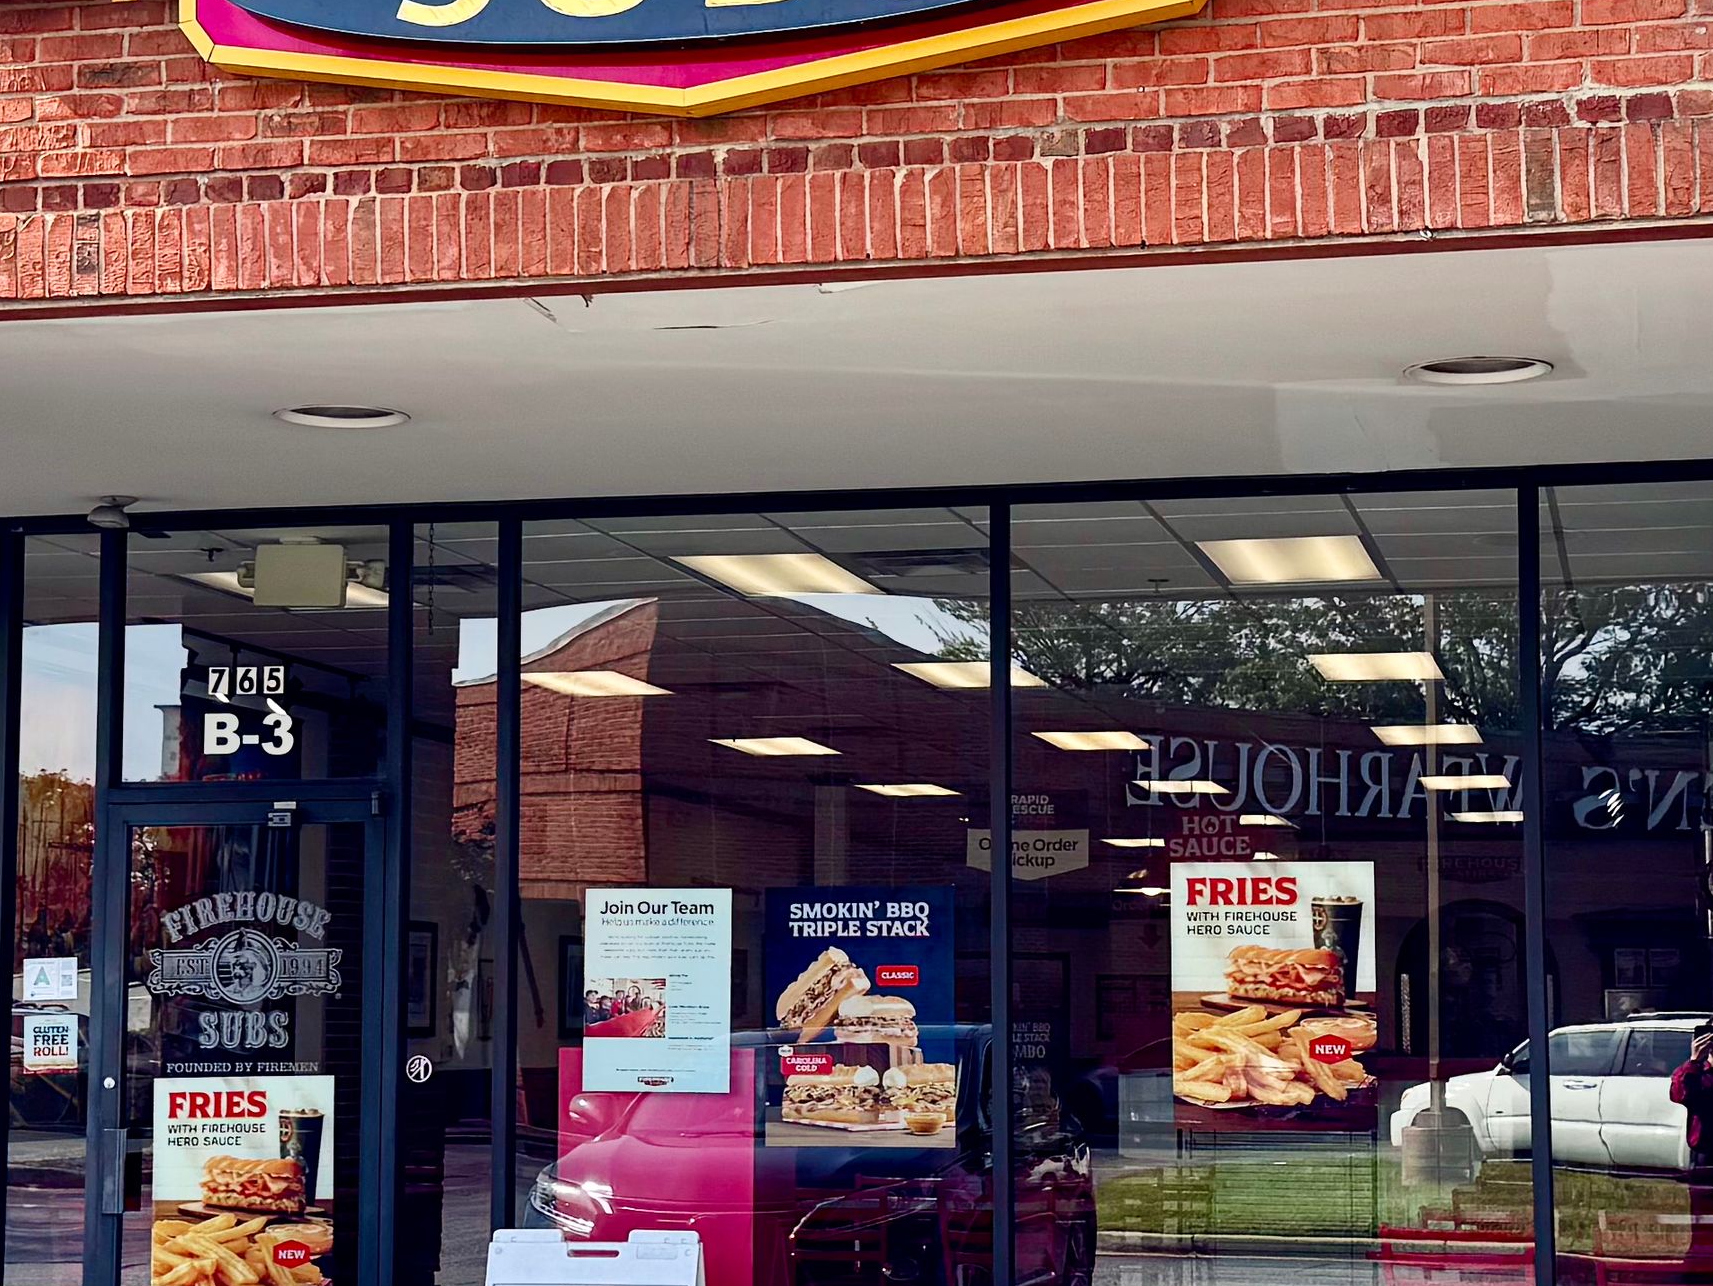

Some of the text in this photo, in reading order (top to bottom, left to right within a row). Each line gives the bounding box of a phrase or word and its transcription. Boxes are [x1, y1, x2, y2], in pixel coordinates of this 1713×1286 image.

[210, 666, 282, 694] 765
[204, 712, 295, 756] B-3
[1011, 795, 1049, 804] RAPID
[1012, 804, 1055, 815] ESCUE
[1182, 816, 1236, 835] HOT
[1033, 838, 1078, 852] Order
[1169, 836, 1251, 857] SAUCE
[1012, 853, 1055, 869] ickup
[1185, 876, 1299, 907] FRIES
[600, 900, 714, 915] Join Our Team
[886, 901, 930, 924] BBQ
[161, 890, 332, 943] FIREHOUSE
[1187, 911, 1297, 922] WITH FIREHOUSE
[789, 920, 930, 937] TRIPLE STACK
[1187, 924, 1271, 935] HERO SAUCE
[33, 965, 51, 986] A
[198, 1010, 290, 1049] SUBS
[33, 1034, 69, 1046] FREE
[33, 1046, 69, 1057] ROLL!
[1314, 1045, 1346, 1055] NEW
[166, 1061, 319, 1073] FOUNDED BY FIREMEN
[168, 1091, 268, 1119] FRIES
[168, 1123, 266, 1134] WITH FIREHOUSE
[168, 1136, 242, 1147] HERO SAUCE
[278, 1250, 305, 1260] NEW
